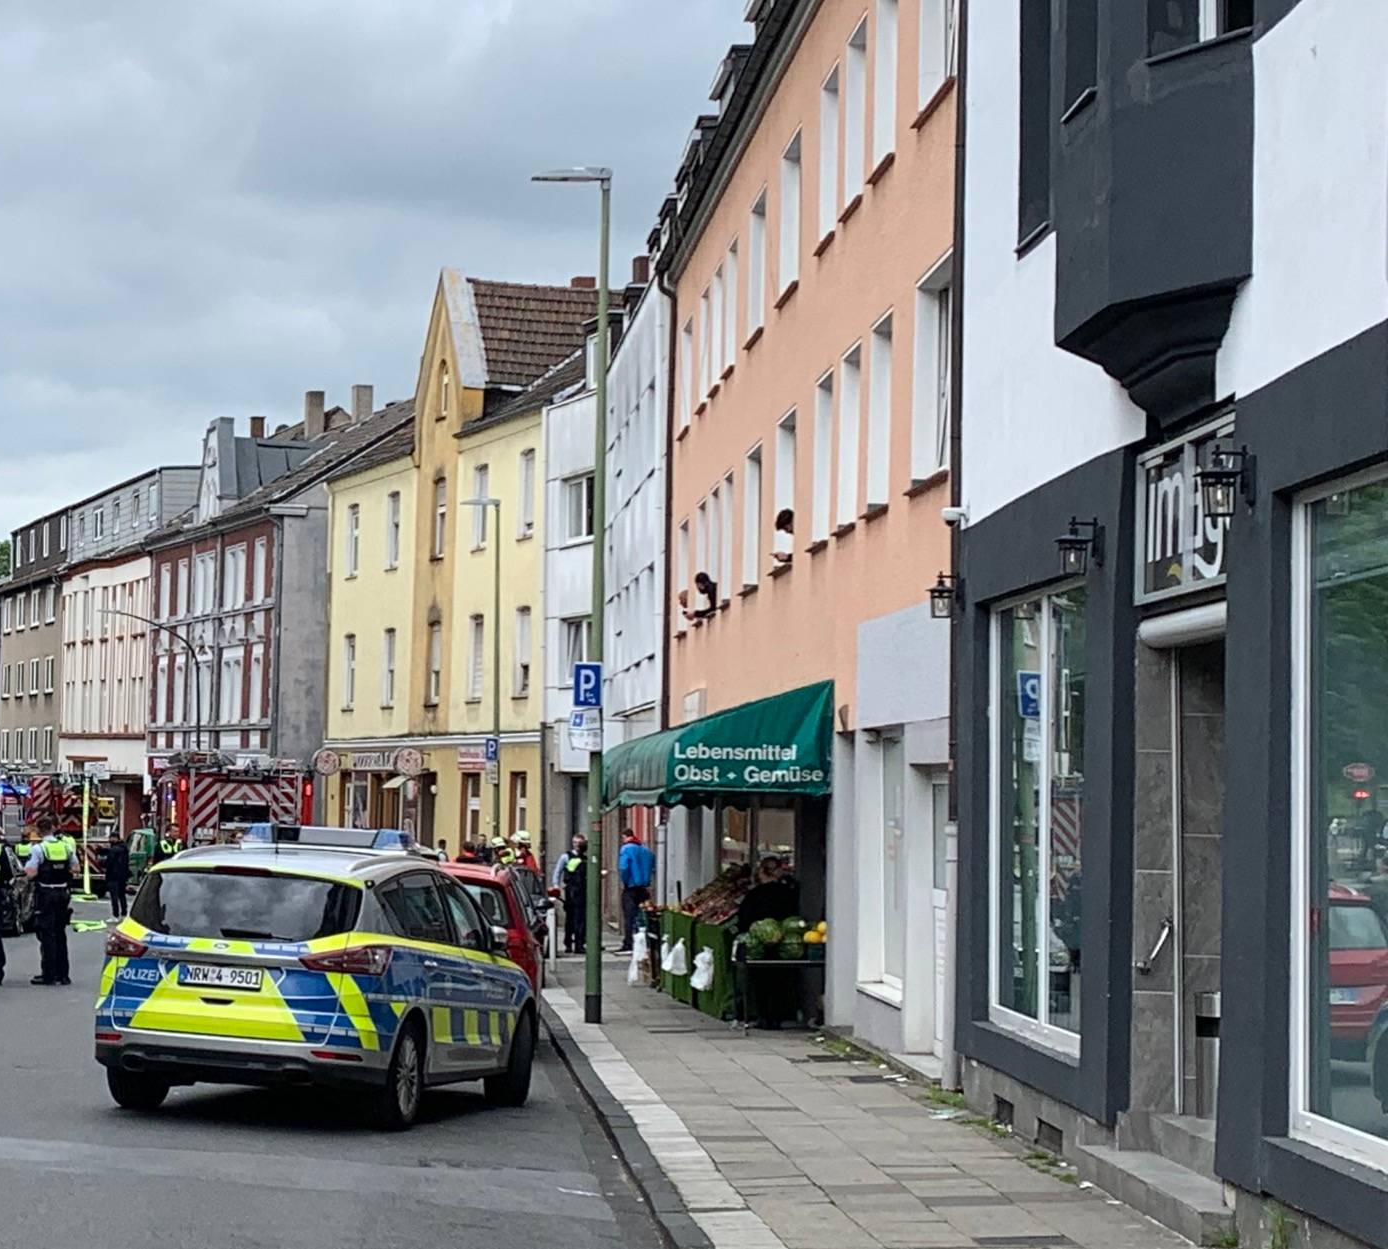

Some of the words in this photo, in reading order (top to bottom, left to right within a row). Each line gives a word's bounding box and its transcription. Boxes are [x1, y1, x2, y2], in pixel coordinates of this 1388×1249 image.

[579, 668, 596, 702] P
[673, 742, 798, 761] Lebensmittel
[673, 764, 720, 782] Obst
[743, 765, 825, 783] Gemüse
[116, 967, 160, 982] POLIZEI
[189, 965, 211, 979] NRW
